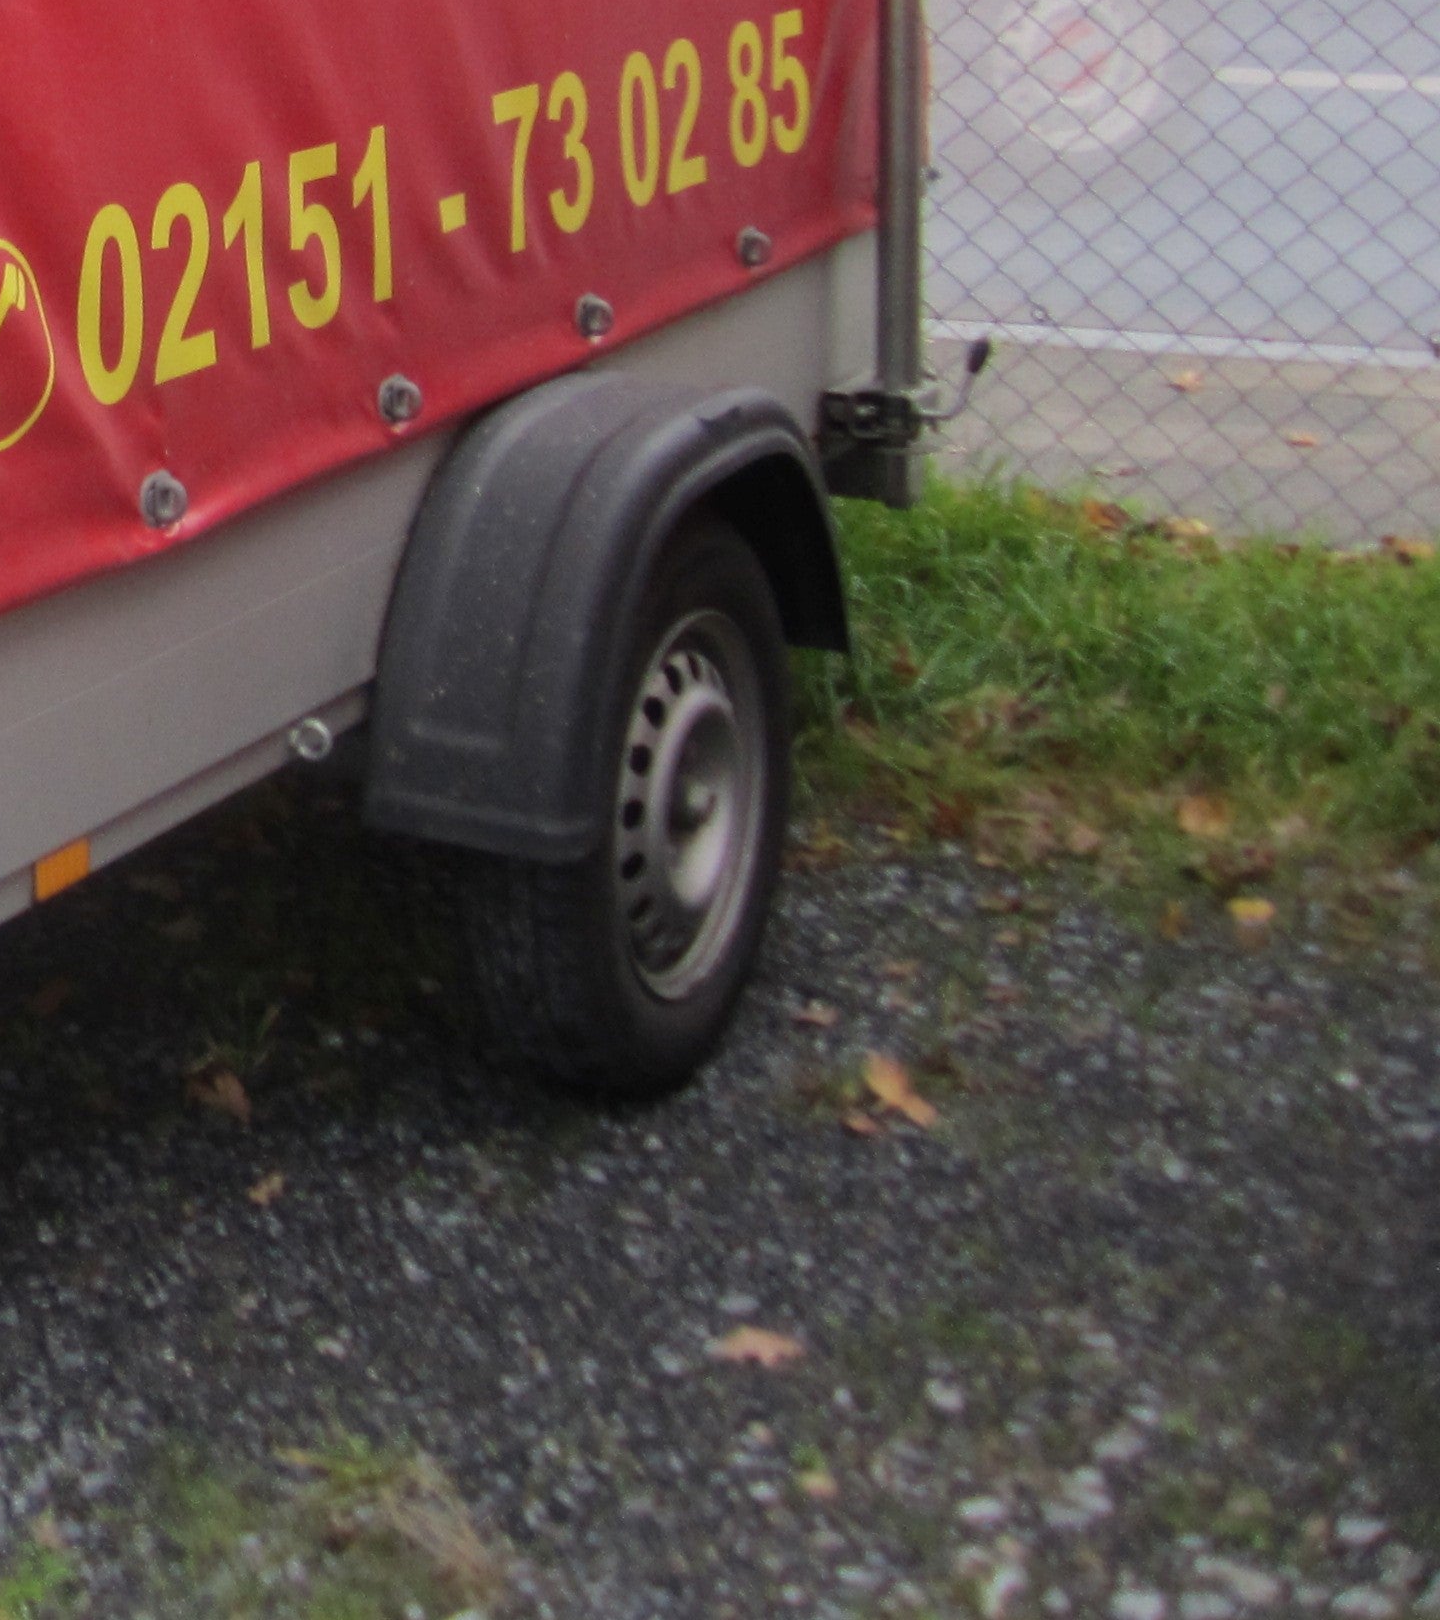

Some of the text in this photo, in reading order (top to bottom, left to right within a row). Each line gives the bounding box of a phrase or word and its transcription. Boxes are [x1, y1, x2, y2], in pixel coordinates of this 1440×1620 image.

[78, 126, 391, 404] 02151
[493, 72, 593, 251] 73
[620, 39, 706, 206] 02
[729, 10, 809, 166] 85
